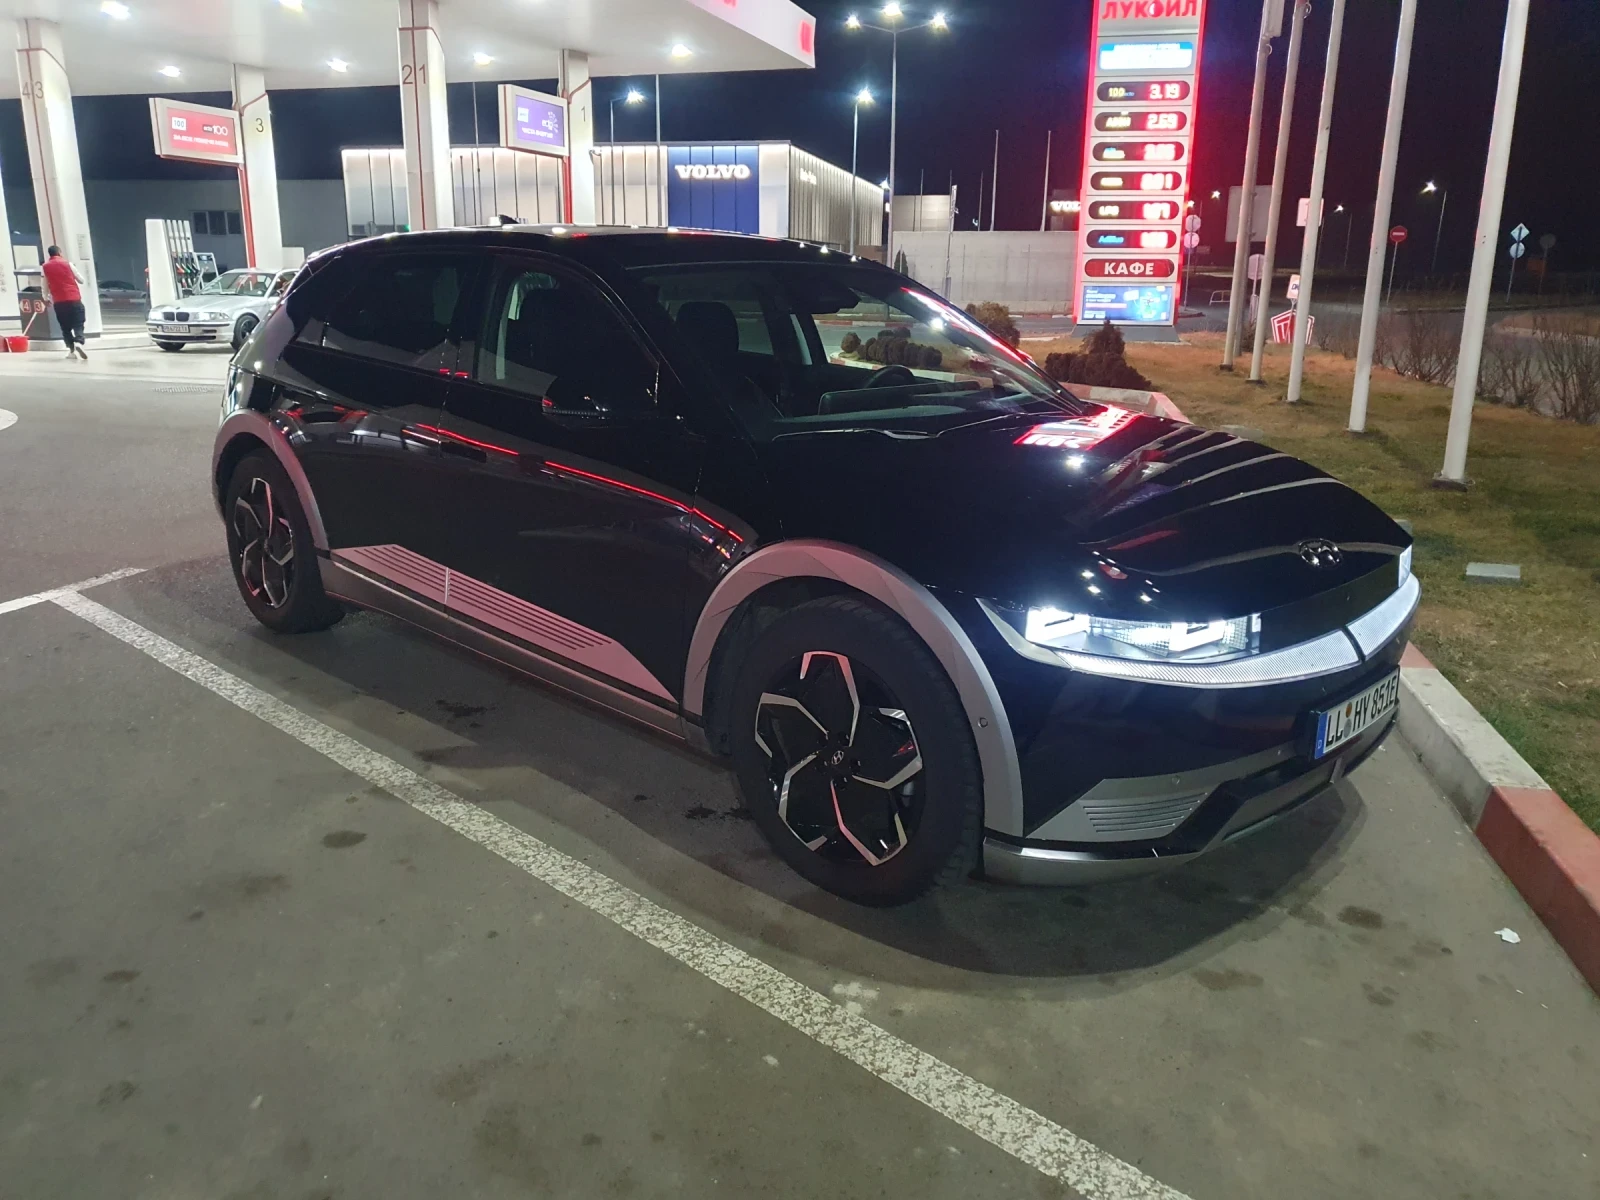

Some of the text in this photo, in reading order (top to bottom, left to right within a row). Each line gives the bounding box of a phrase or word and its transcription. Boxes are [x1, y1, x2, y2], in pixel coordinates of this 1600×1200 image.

[402, 64, 413, 85] 2
[418, 64, 426, 85] 1
[22, 82, 31, 99] 4
[35, 81, 44, 99] 3
[580, 105, 586, 122] 1
[255, 117, 264, 133] 3
[675, 164, 751, 179] VOLVO
[1104, 262, 1155, 275] КАФЕ
[1326, 711, 1343, 746] LL
[1353, 694, 1371, 732] HY
